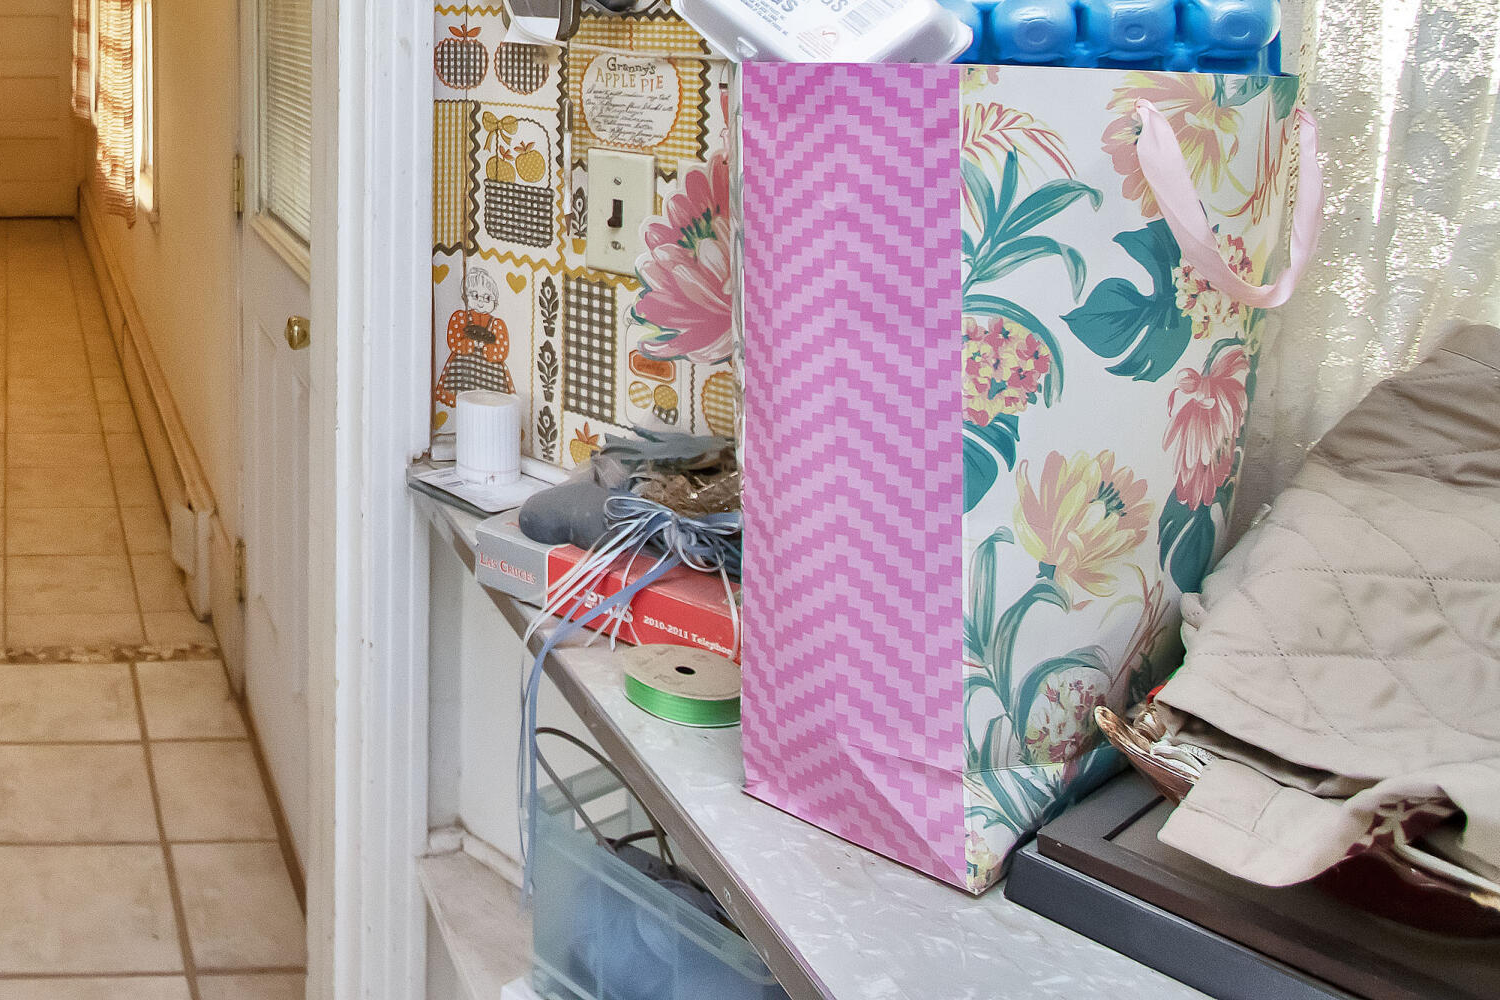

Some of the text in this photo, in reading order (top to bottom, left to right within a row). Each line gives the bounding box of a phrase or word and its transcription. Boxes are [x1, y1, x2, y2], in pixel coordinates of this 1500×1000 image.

[595, 67, 664, 93] APPLE PIE
[606, 56, 656, 76] Granny's
[480, 551, 537, 585] LAS CRUCES
[643, 615, 734, 656] 2010-2011 Telephon
